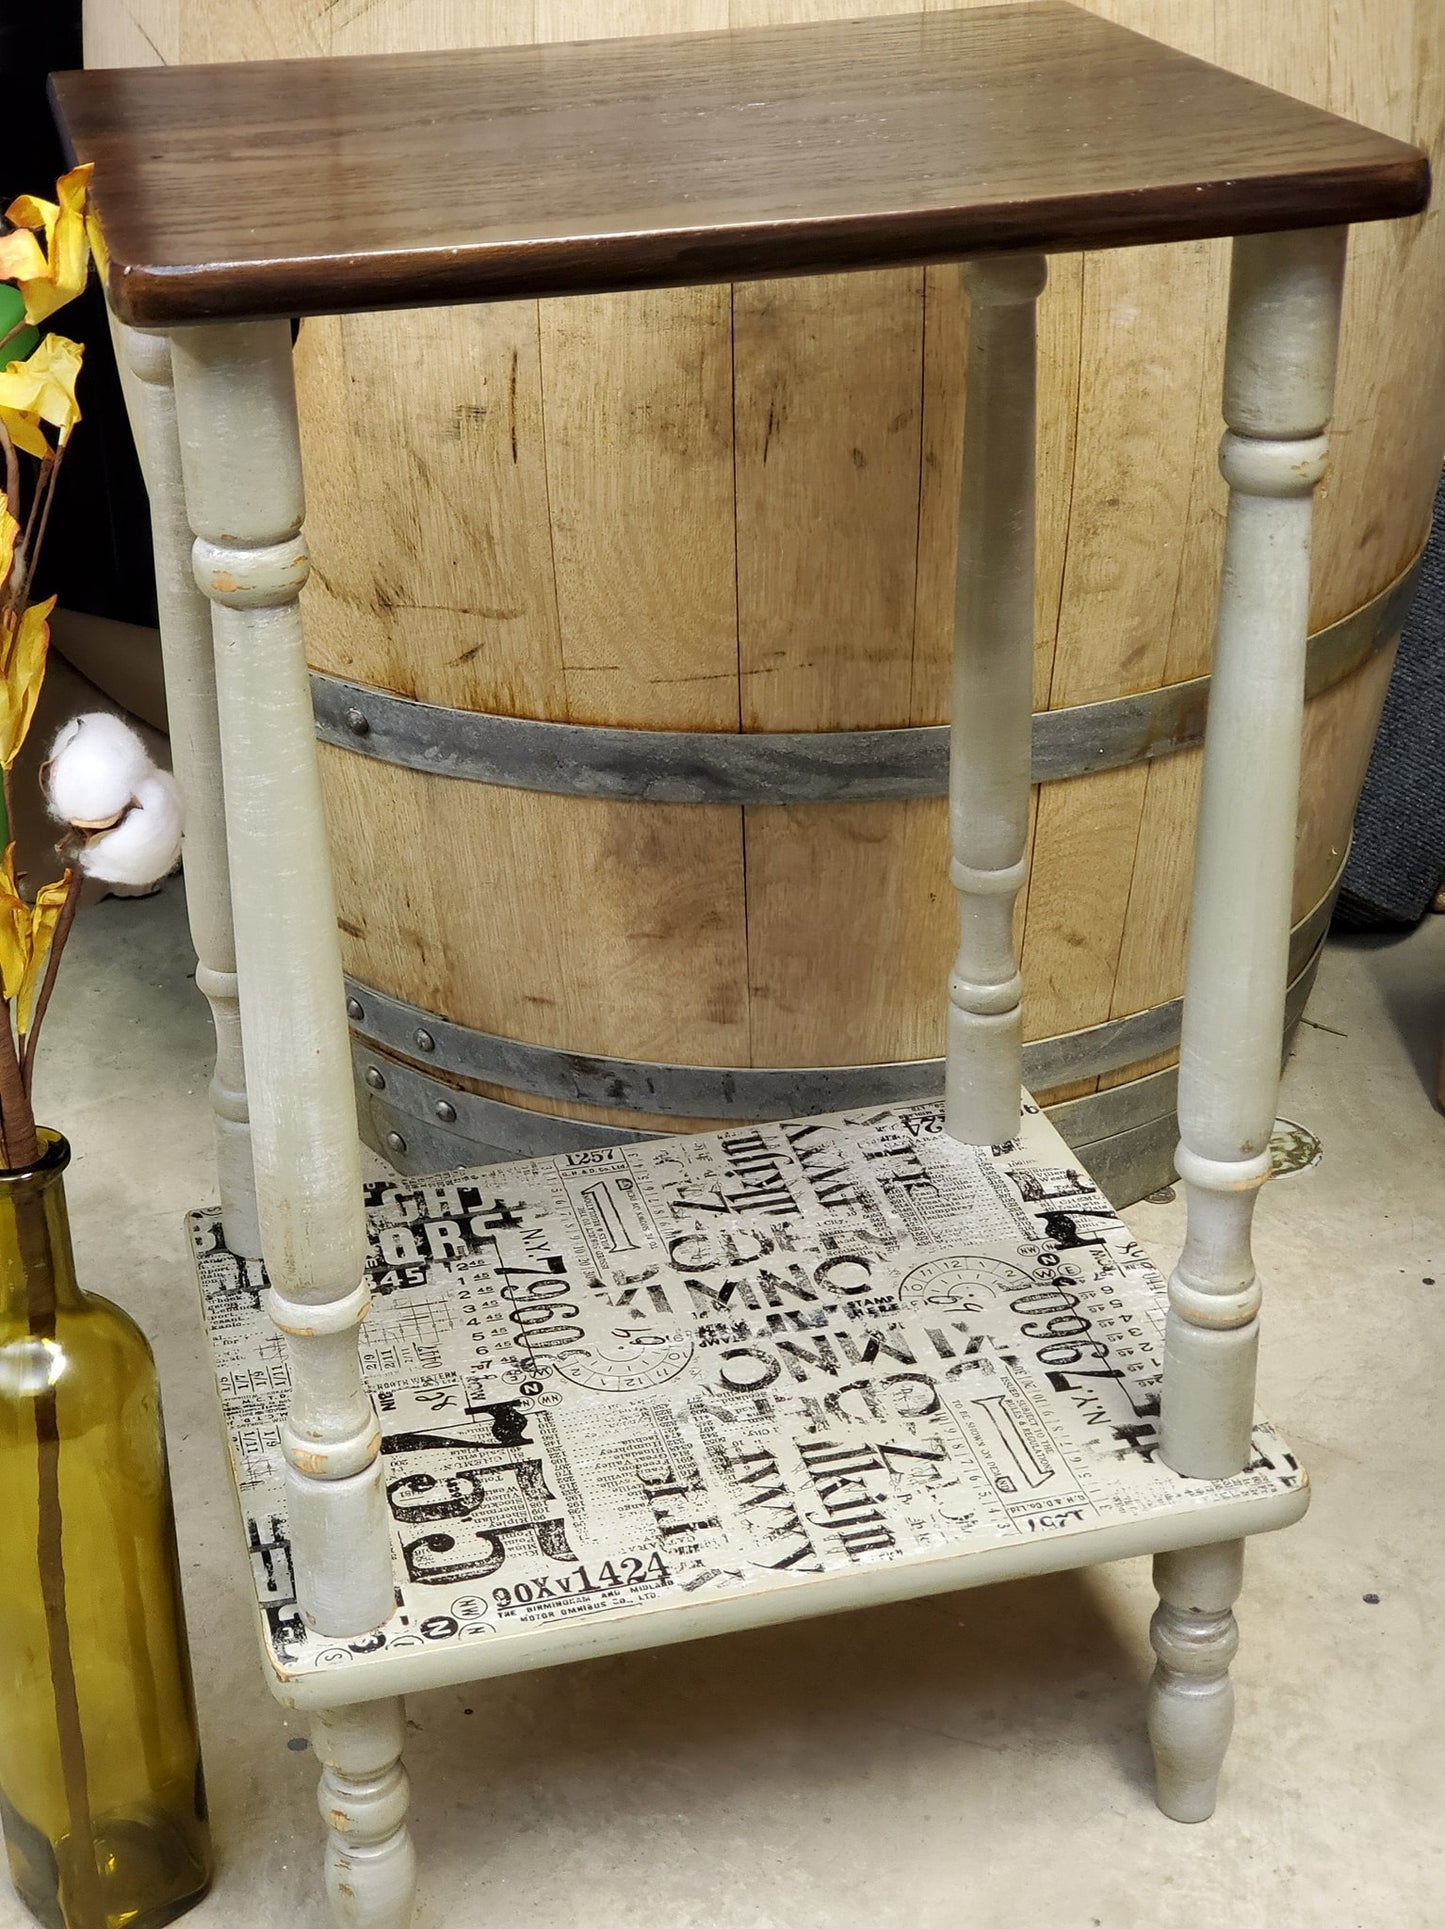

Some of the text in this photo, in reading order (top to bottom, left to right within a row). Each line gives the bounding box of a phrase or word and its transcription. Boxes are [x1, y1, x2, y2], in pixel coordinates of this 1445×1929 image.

[943, 1260, 960, 1269] 12
[498, 1611, 517, 1619] THE
[520, 1610, 555, 1623] MOTOR
